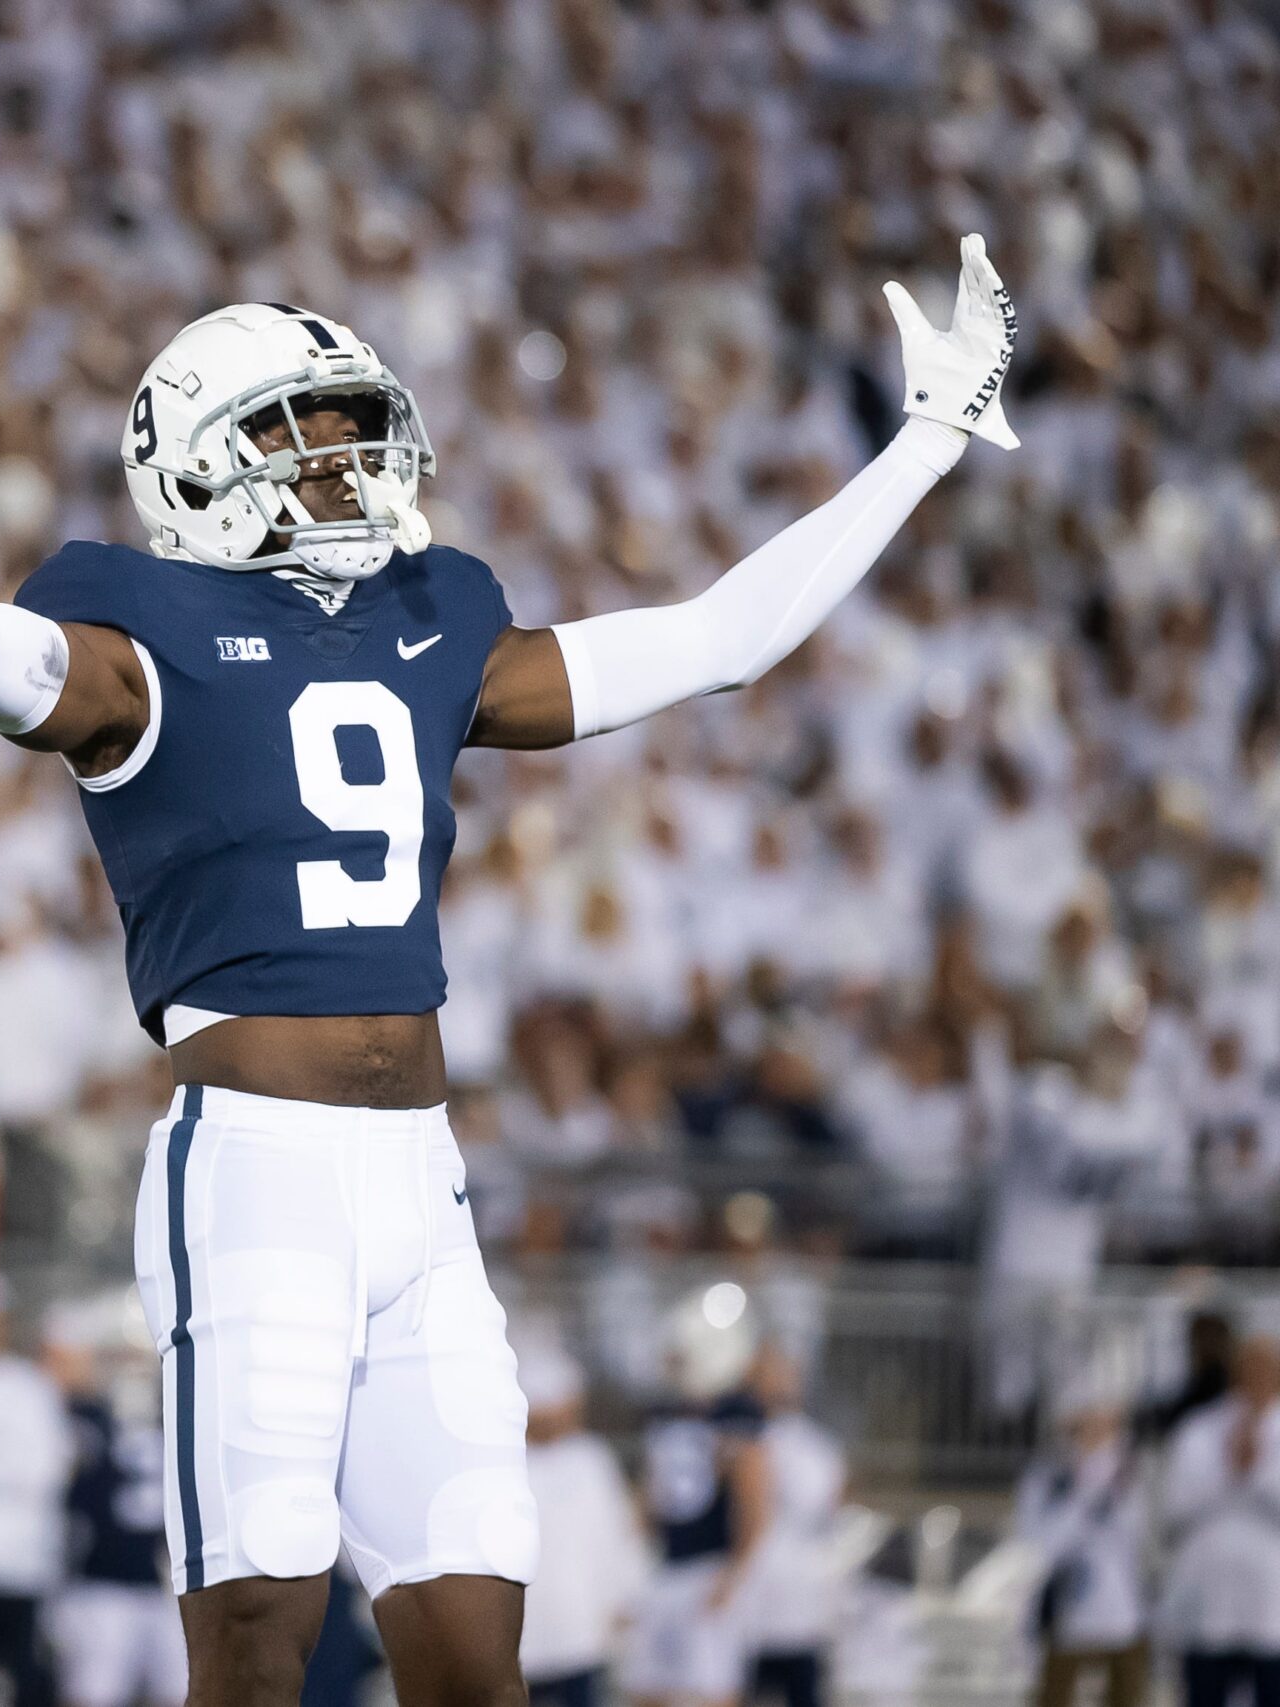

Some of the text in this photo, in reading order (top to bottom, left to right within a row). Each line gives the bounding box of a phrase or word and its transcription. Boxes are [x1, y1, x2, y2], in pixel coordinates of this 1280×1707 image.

[963, 287, 1018, 422] PENN STATE
[132, 385, 158, 464] 9
[288, 681, 424, 929] 9
